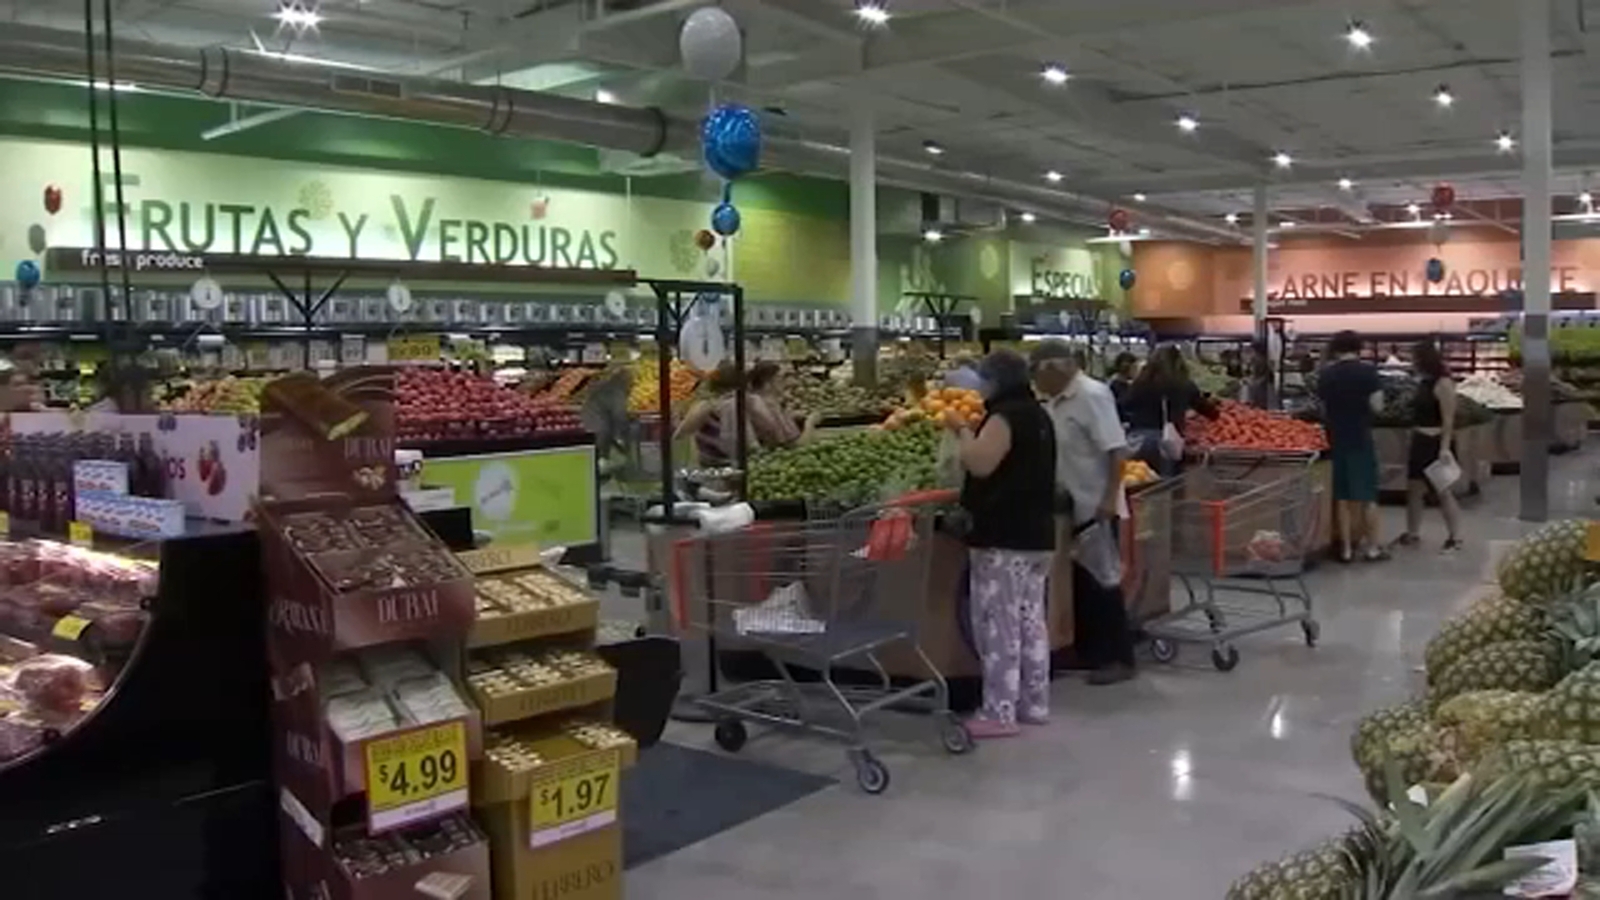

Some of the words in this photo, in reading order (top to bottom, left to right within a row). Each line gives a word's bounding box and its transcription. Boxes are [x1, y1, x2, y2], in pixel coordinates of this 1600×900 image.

[93, 172, 313, 256] FRUTAS
[337, 212, 368, 259] Y
[390, 195, 618, 270] VERDURAS
[136, 253, 204, 270] produce
[1369, 270, 1408, 298] EN
[379, 750, 457, 796] $4.99
[540, 773, 611, 819] $1.97
